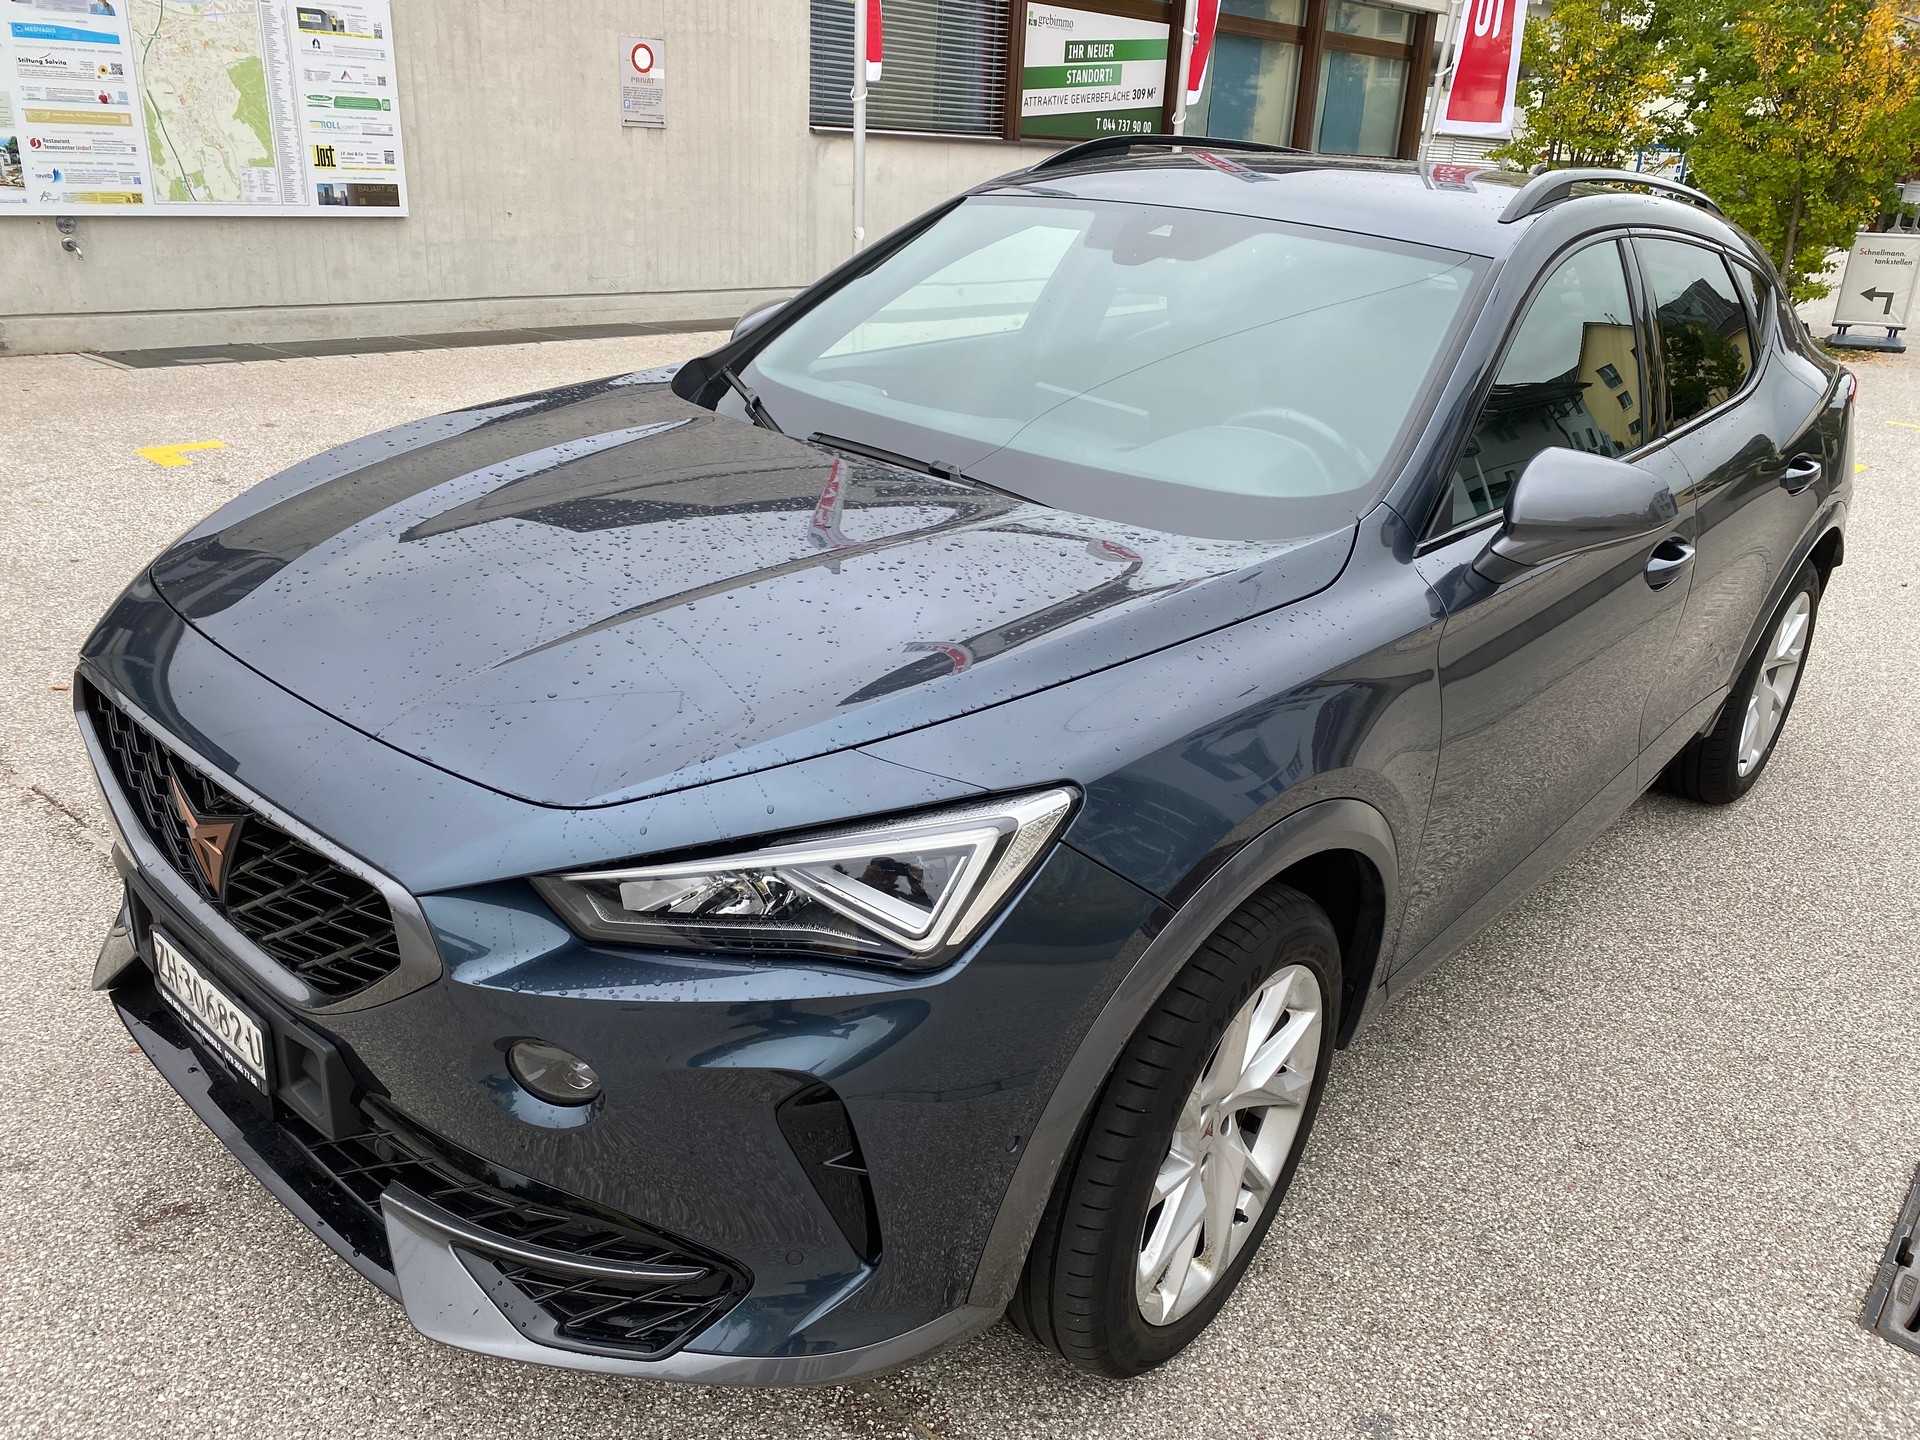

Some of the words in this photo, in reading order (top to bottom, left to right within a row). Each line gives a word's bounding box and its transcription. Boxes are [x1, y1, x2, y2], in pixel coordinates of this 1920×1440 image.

[1038, 14, 1074, 29] grebimmo
[1068, 44, 1084, 59] IHR
[1087, 43, 1114, 58] NEUER
[17, 57, 43, 65] Stiftung
[630, 76, 655, 84] PRIVAT
[1066, 68, 1113, 84] STANDORT!
[1023, 95, 1069, 107] ATTRAKTIVE
[1071, 90, 1130, 104] GEWERBEFLÄCHE
[1132, 88, 1146, 100] 309
[1096, 118, 1101, 130] T
[1102, 118, 1116, 131] 044
[1118, 119, 1130, 132] 737
[1132, 120, 1141, 133] 90
[1143, 121, 1152, 133] 00
[387, 185, 397, 193] AG
[1874, 258, 1913, 266] tankstellen
